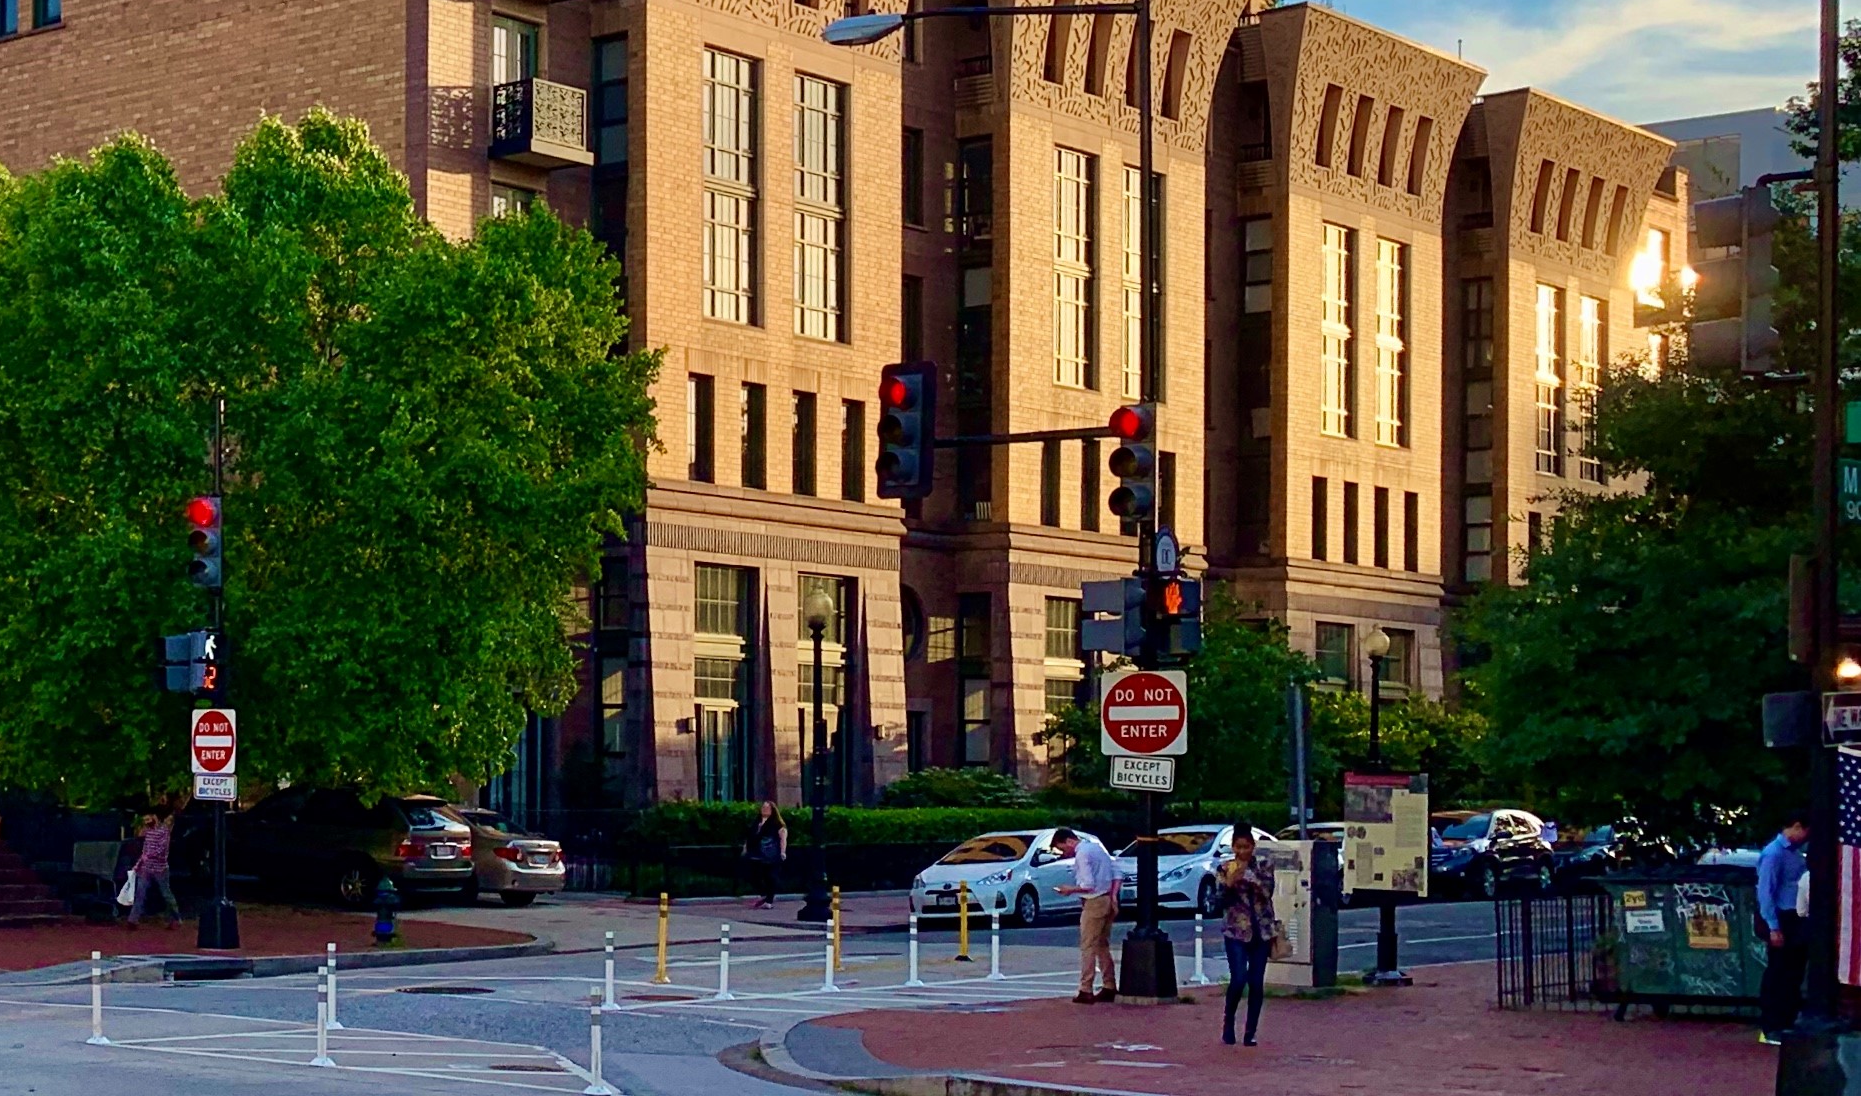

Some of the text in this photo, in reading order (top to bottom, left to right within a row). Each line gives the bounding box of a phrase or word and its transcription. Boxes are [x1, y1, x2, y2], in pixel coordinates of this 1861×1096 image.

[1844, 466, 1857, 494] M
[1115, 688, 1173, 702] DO NOT
[198, 722, 229, 733] DO NOT
[1121, 724, 1167, 738] ENTER
[201, 750, 226, 761] ENTER
[1124, 760, 1160, 771] EXCEPT
[203, 777, 228, 786] EXCEPT
[1117, 773, 1167, 785] BICYCLES
[198, 787, 231, 796] BICYCLES
